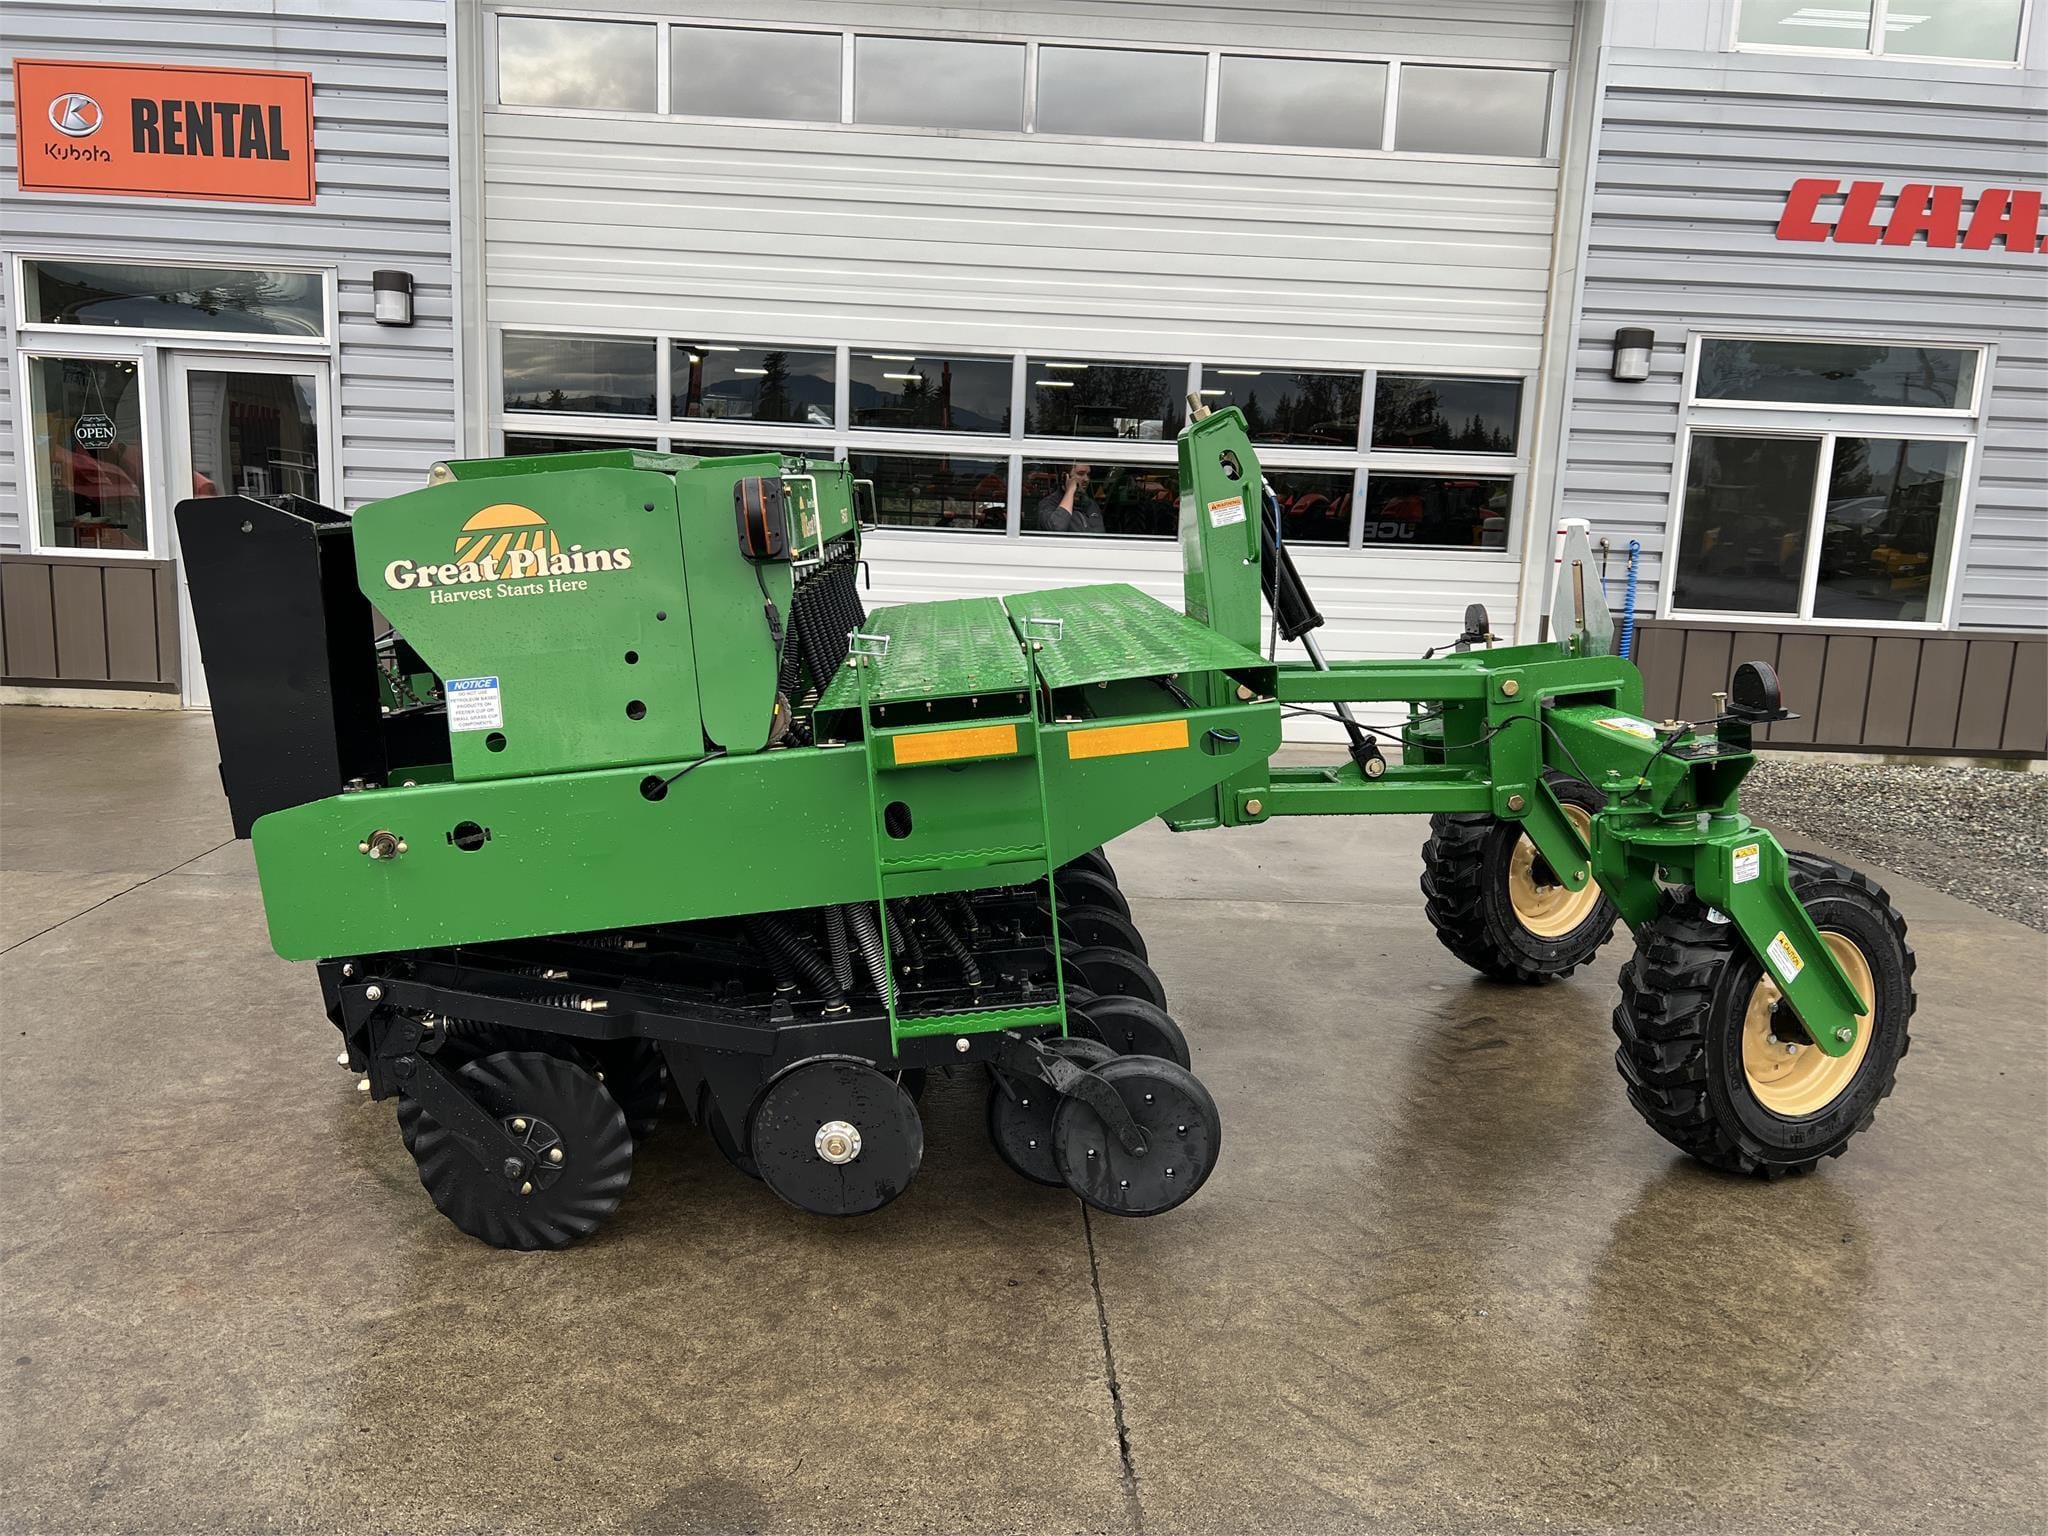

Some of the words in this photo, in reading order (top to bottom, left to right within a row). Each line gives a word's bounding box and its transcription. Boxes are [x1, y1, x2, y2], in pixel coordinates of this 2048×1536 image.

[131, 98, 290, 161] RENTAL
[44, 143, 112, 162] Kubota
[1776, 178, 2048, 253] CLAA
[76, 427, 114, 439] OPEN
[384, 553, 501, 591] Great
[507, 544, 632, 579] Plains
[430, 586, 492, 604] Harvest
[497, 581, 544, 598] Starts
[549, 578, 588, 593] Here
[454, 679, 492, 690] NOTICE
